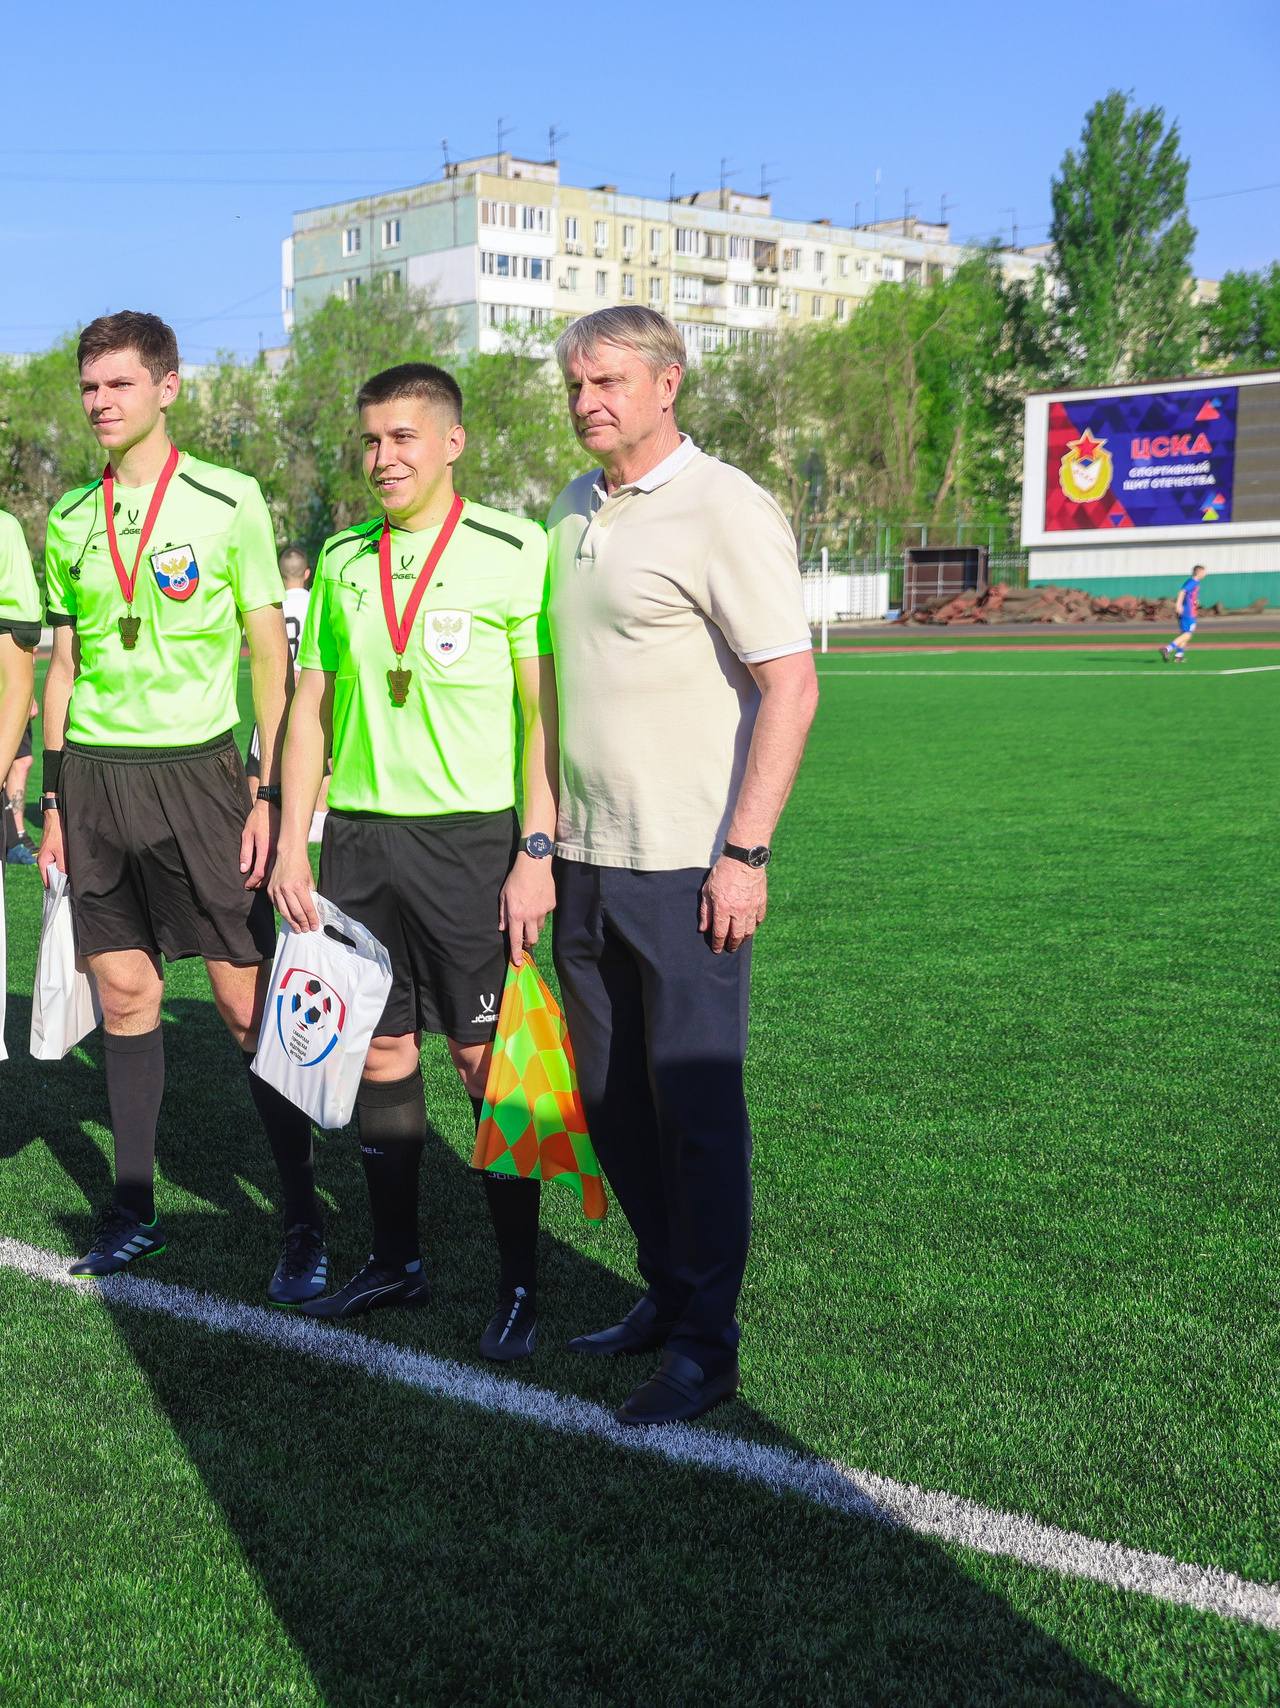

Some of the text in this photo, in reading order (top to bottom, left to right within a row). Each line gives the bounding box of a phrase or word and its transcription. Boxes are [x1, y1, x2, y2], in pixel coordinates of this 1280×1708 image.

[1131, 432, 1213, 460] ЦСКА
[1128, 460, 1211, 478] СПОРТИВНЫЙ
[1123, 474, 1216, 490] ЩИТ ОТЕЧЕСТВА
